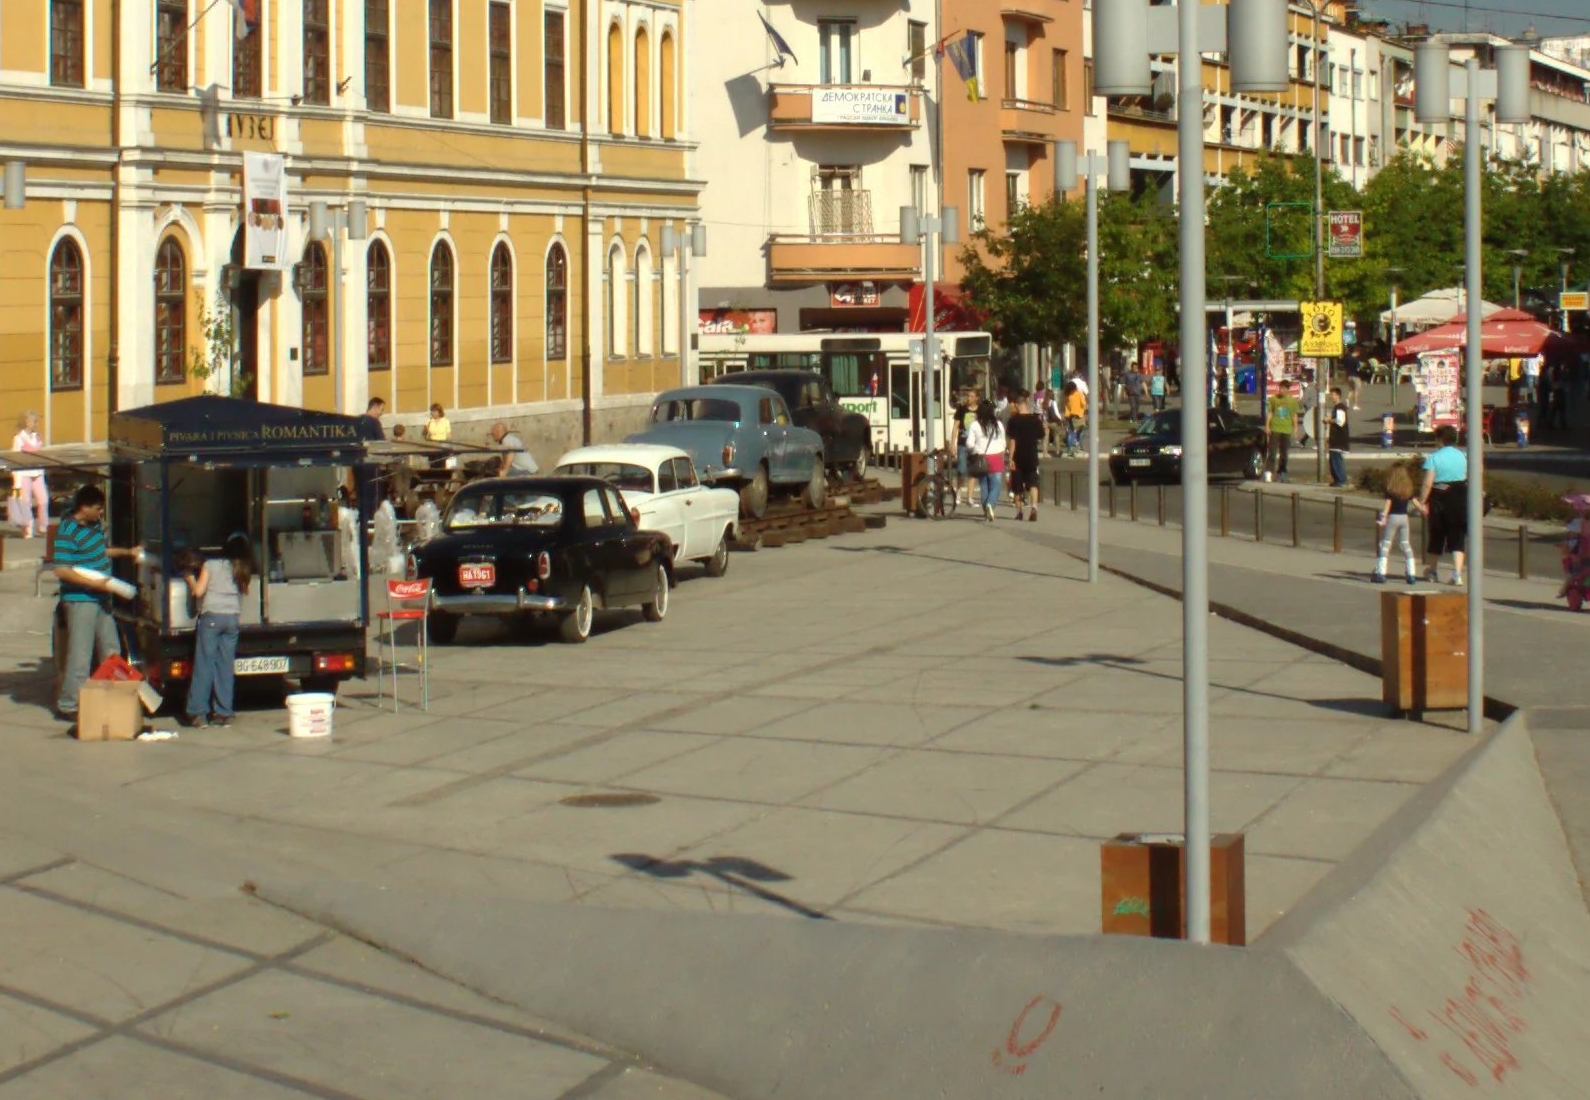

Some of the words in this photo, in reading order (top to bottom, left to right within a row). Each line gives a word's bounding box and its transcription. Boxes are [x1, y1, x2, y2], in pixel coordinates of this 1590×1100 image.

[821, 92, 893, 103] ДЕМОКРАТСКА
[852, 103, 893, 114] СТРАНКА
[1330, 215, 1360, 225] HOTEL
[261, 424, 357, 440] ROMANTIKA
